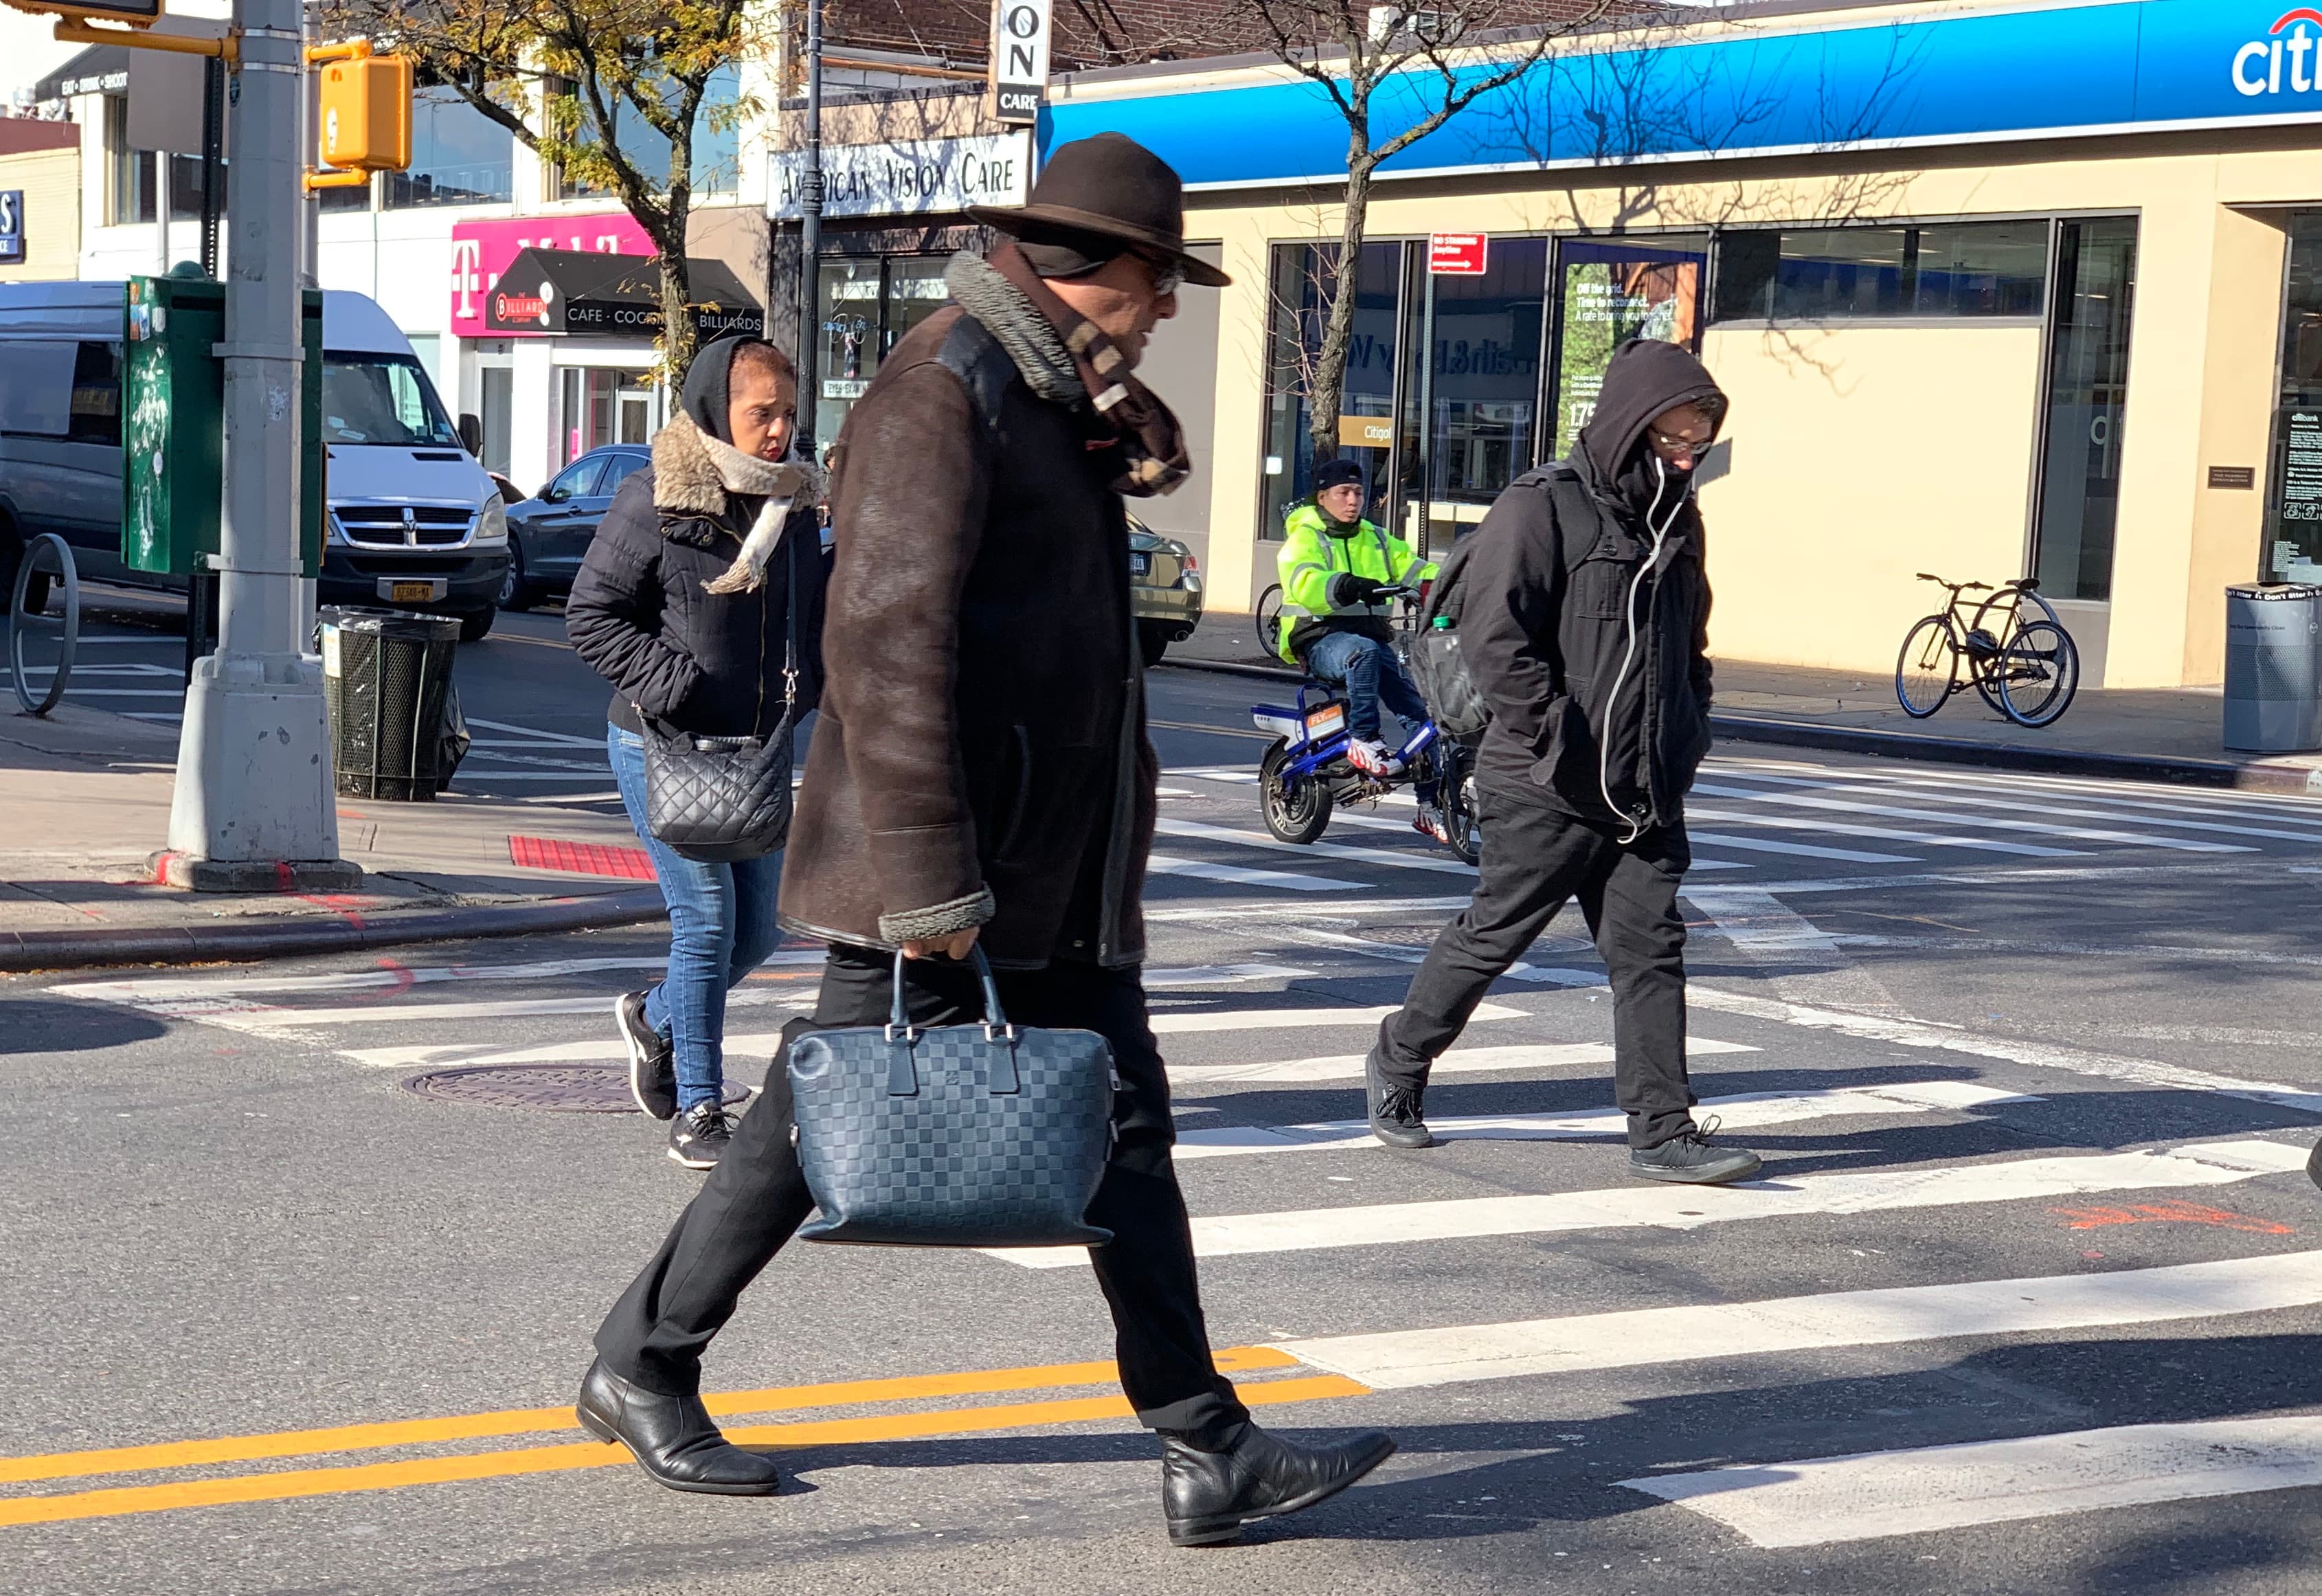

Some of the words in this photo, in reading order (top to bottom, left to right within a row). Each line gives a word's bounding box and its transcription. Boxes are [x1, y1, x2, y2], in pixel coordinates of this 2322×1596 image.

[62, 80, 75, 95] EAT
[104, 72, 128, 89] SHOOT
[1000, 93, 1038, 110] CARE
[781, 166, 870, 204] AMRICAN
[886, 159, 947, 199] VISION
[961, 152, 1013, 194] CARE
[1433, 236, 1443, 245] NO
[1444, 236, 1478, 245] STANDING
[1577, 283, 1589, 293] Off
[1591, 283, 1603, 293] the
[1605, 283, 1623, 296] grid.
[499, 299, 543, 315] BILLIARD
[1577, 297, 1595, 308] Time
[1597, 297, 1605, 308] to
[1607, 297, 1649, 308] reconnect.
[567, 308, 602, 323] CAFE
[699, 314, 762, 331] BILLIARDS
[1575, 311, 1581, 321] A
[1583, 311, 1597, 321] rate
[1598, 311, 1605, 321] to
[1606, 311, 1624, 323] bring
[1625, 312, 1640, 323] you
[1364, 425, 1392, 442] Citigol
